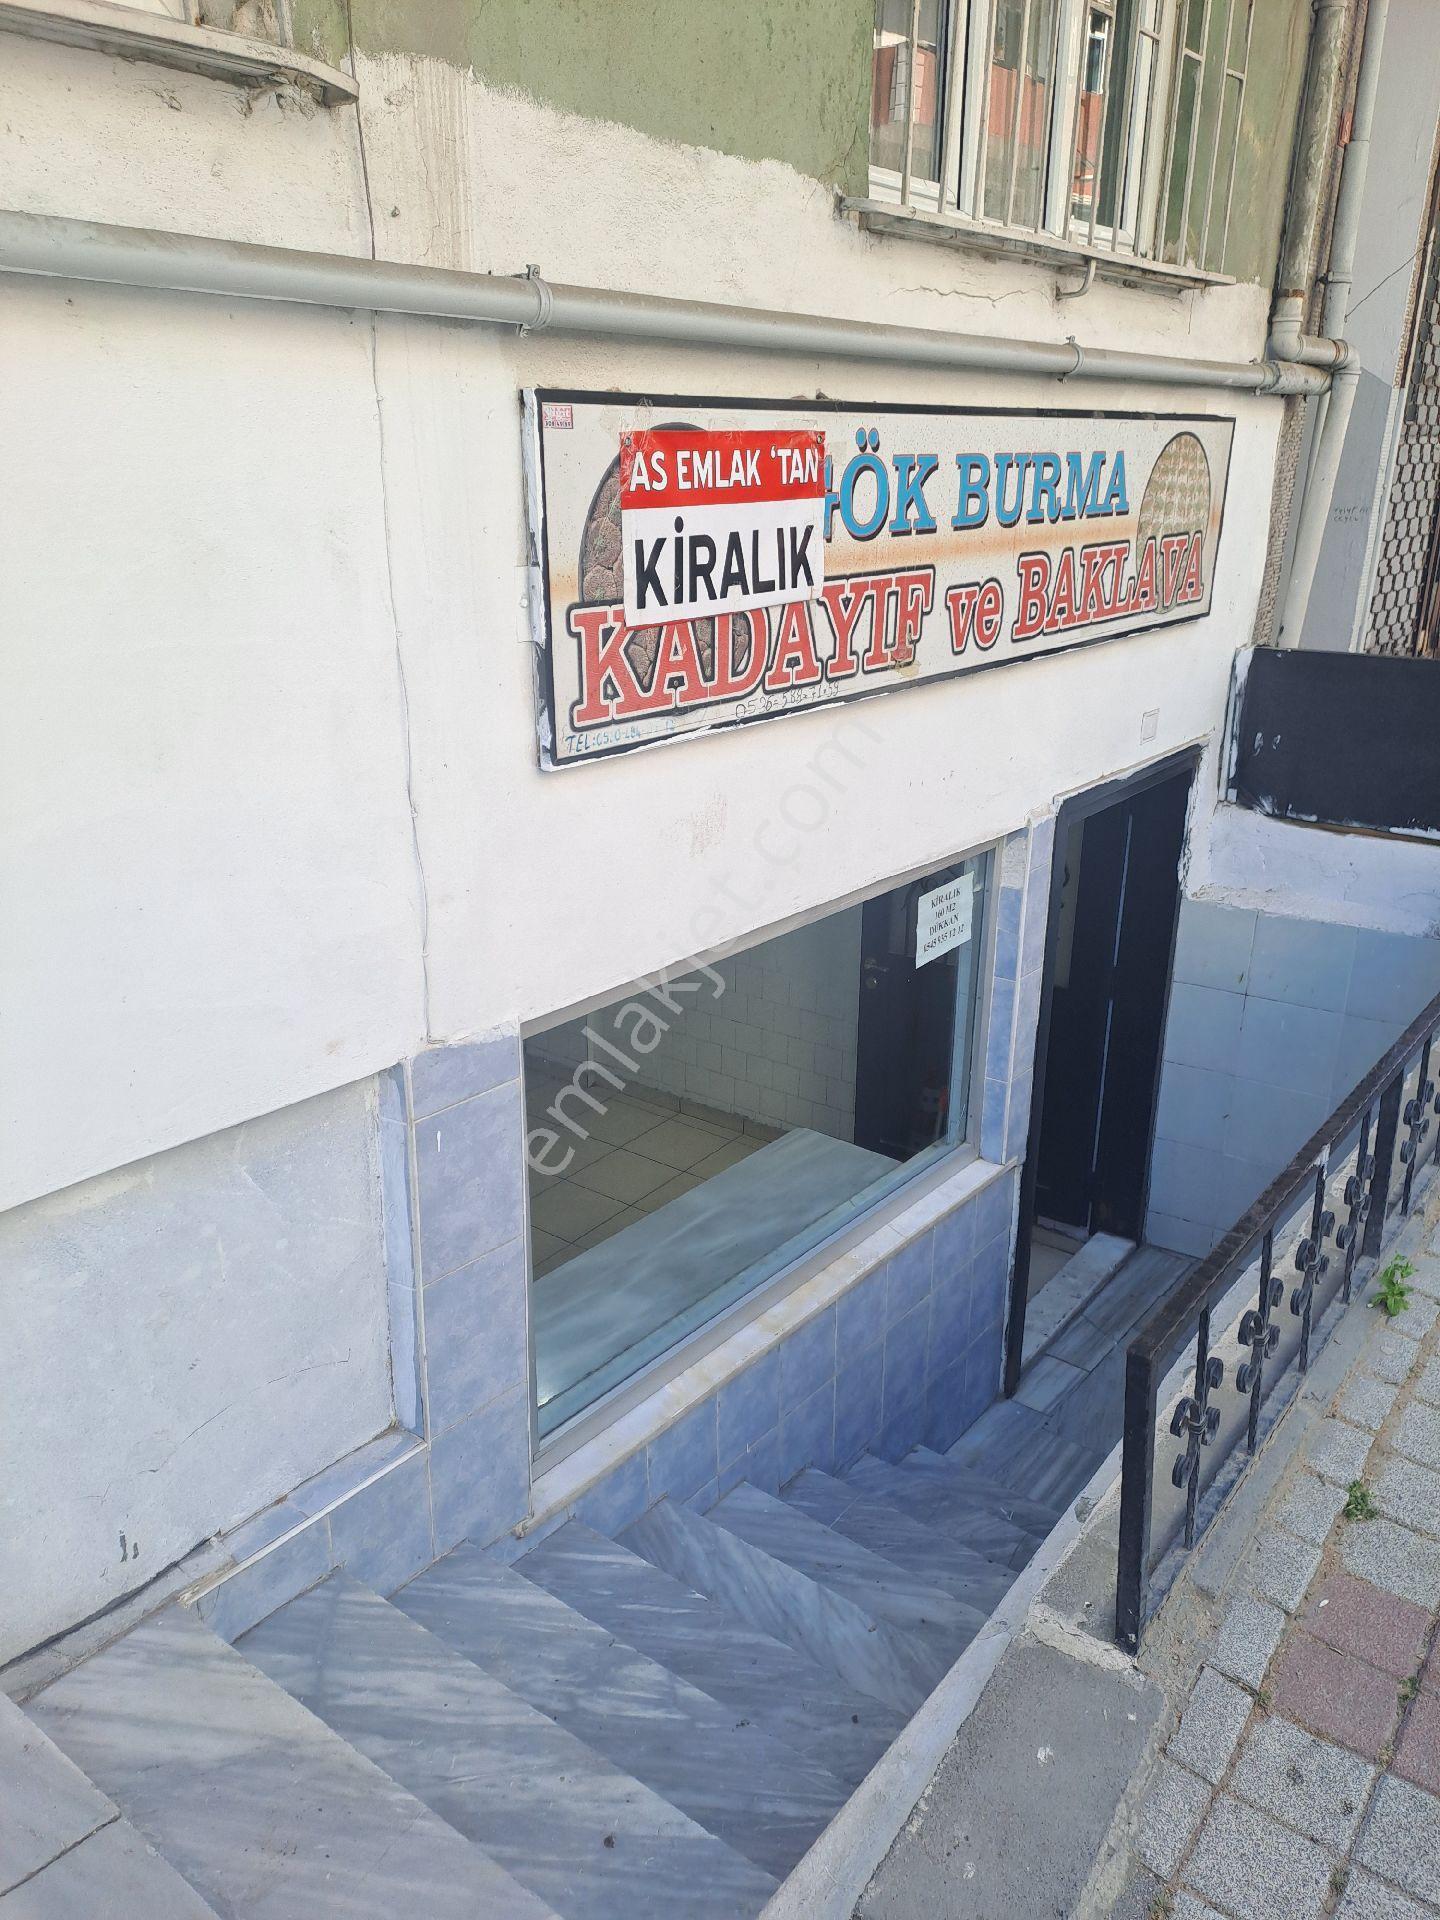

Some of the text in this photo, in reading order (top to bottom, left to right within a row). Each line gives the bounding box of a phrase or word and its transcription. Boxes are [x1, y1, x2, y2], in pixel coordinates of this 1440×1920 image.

[629, 449, 668, 492] AS
[676, 449, 761, 490] EMLAK
[823, 427, 1130, 542] ÖK BURMA
[634, 516, 815, 610] KİRALIK
[566, 530, 1206, 731] KADAYIF ve BAKLAVA
[931, 887, 961, 909] KİRALIK
